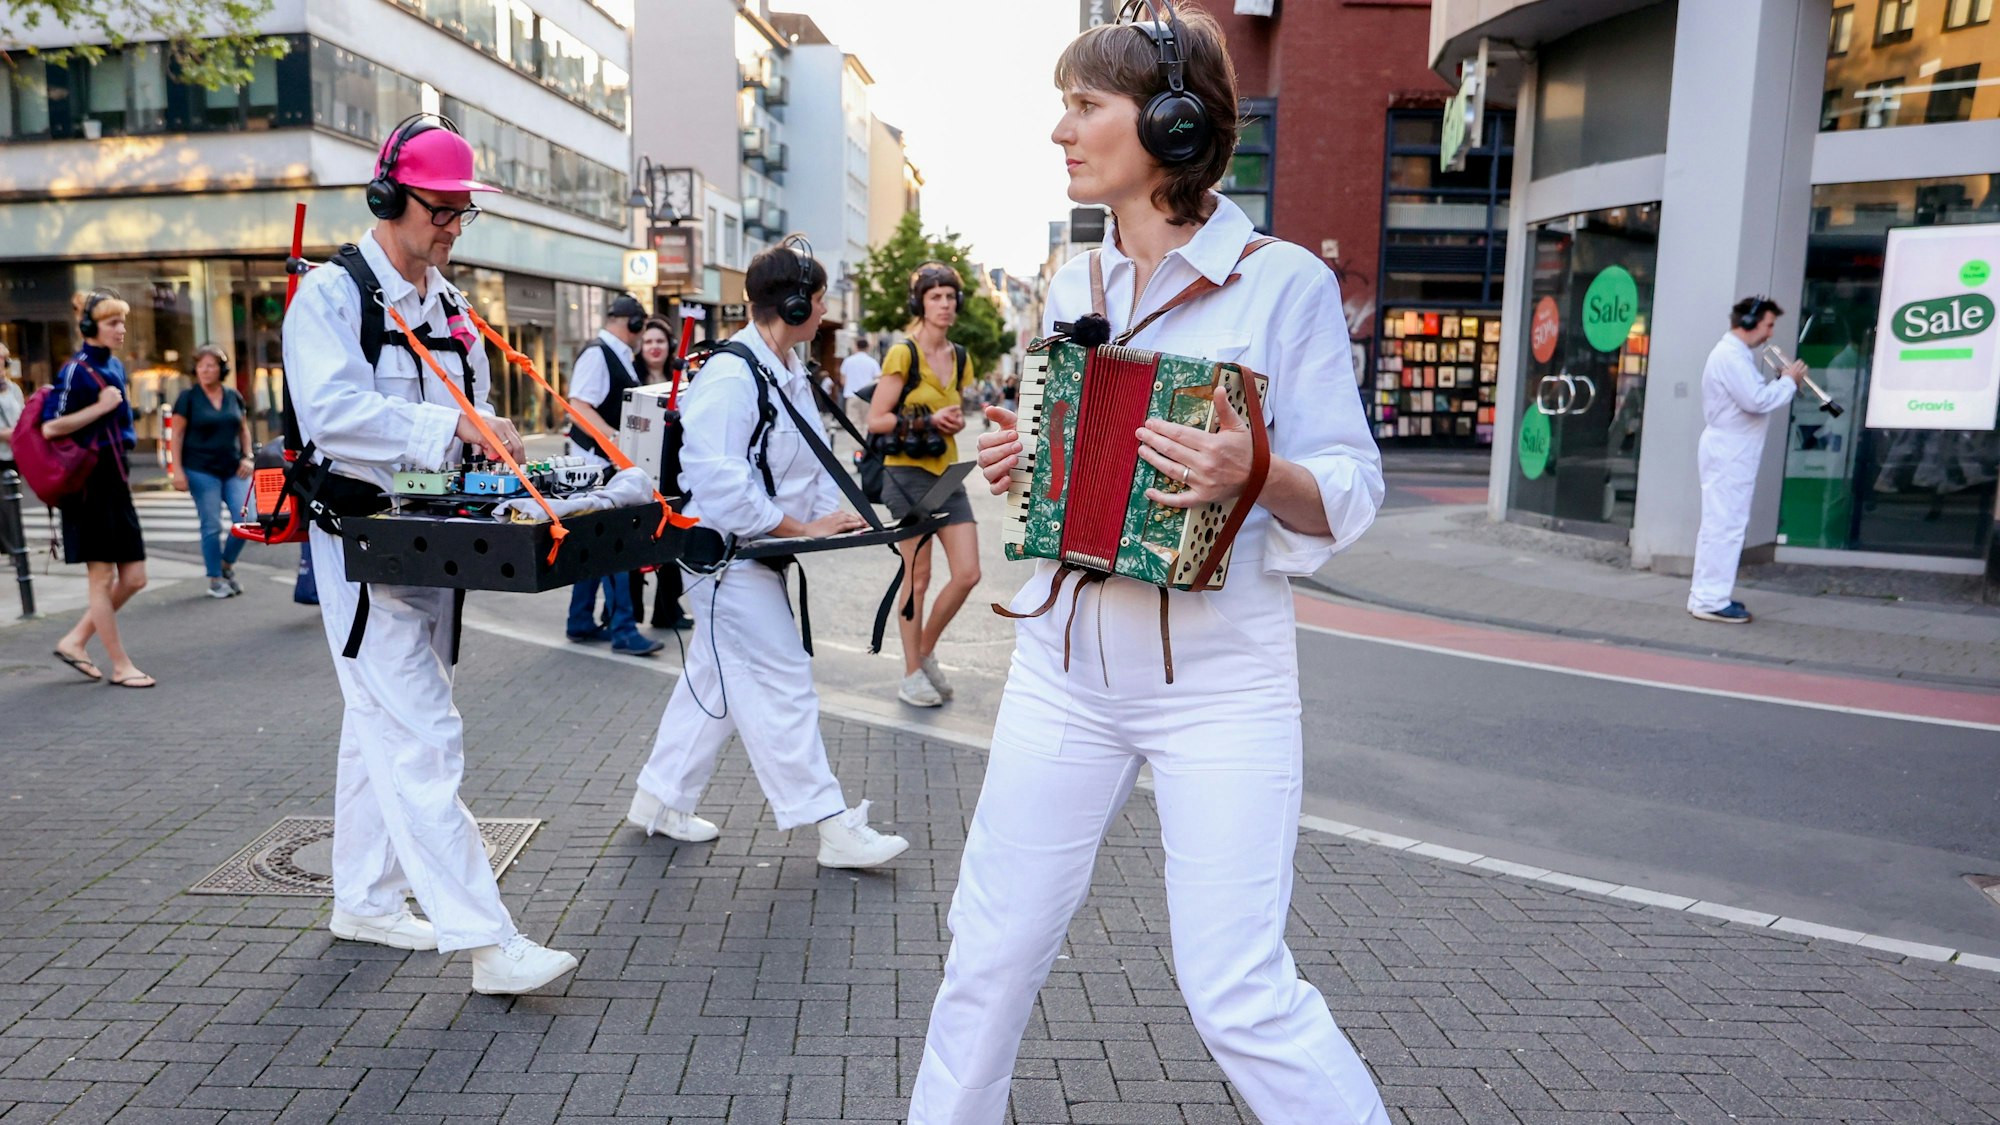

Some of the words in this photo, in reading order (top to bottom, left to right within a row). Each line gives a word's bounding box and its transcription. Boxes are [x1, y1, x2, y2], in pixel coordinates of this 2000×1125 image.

[1588, 295, 1631, 325] Sale
[1904, 299, 1985, 338] Sale
[1907, 399, 1954, 411] Gravis
[1522, 428, 1546, 454] Sale
